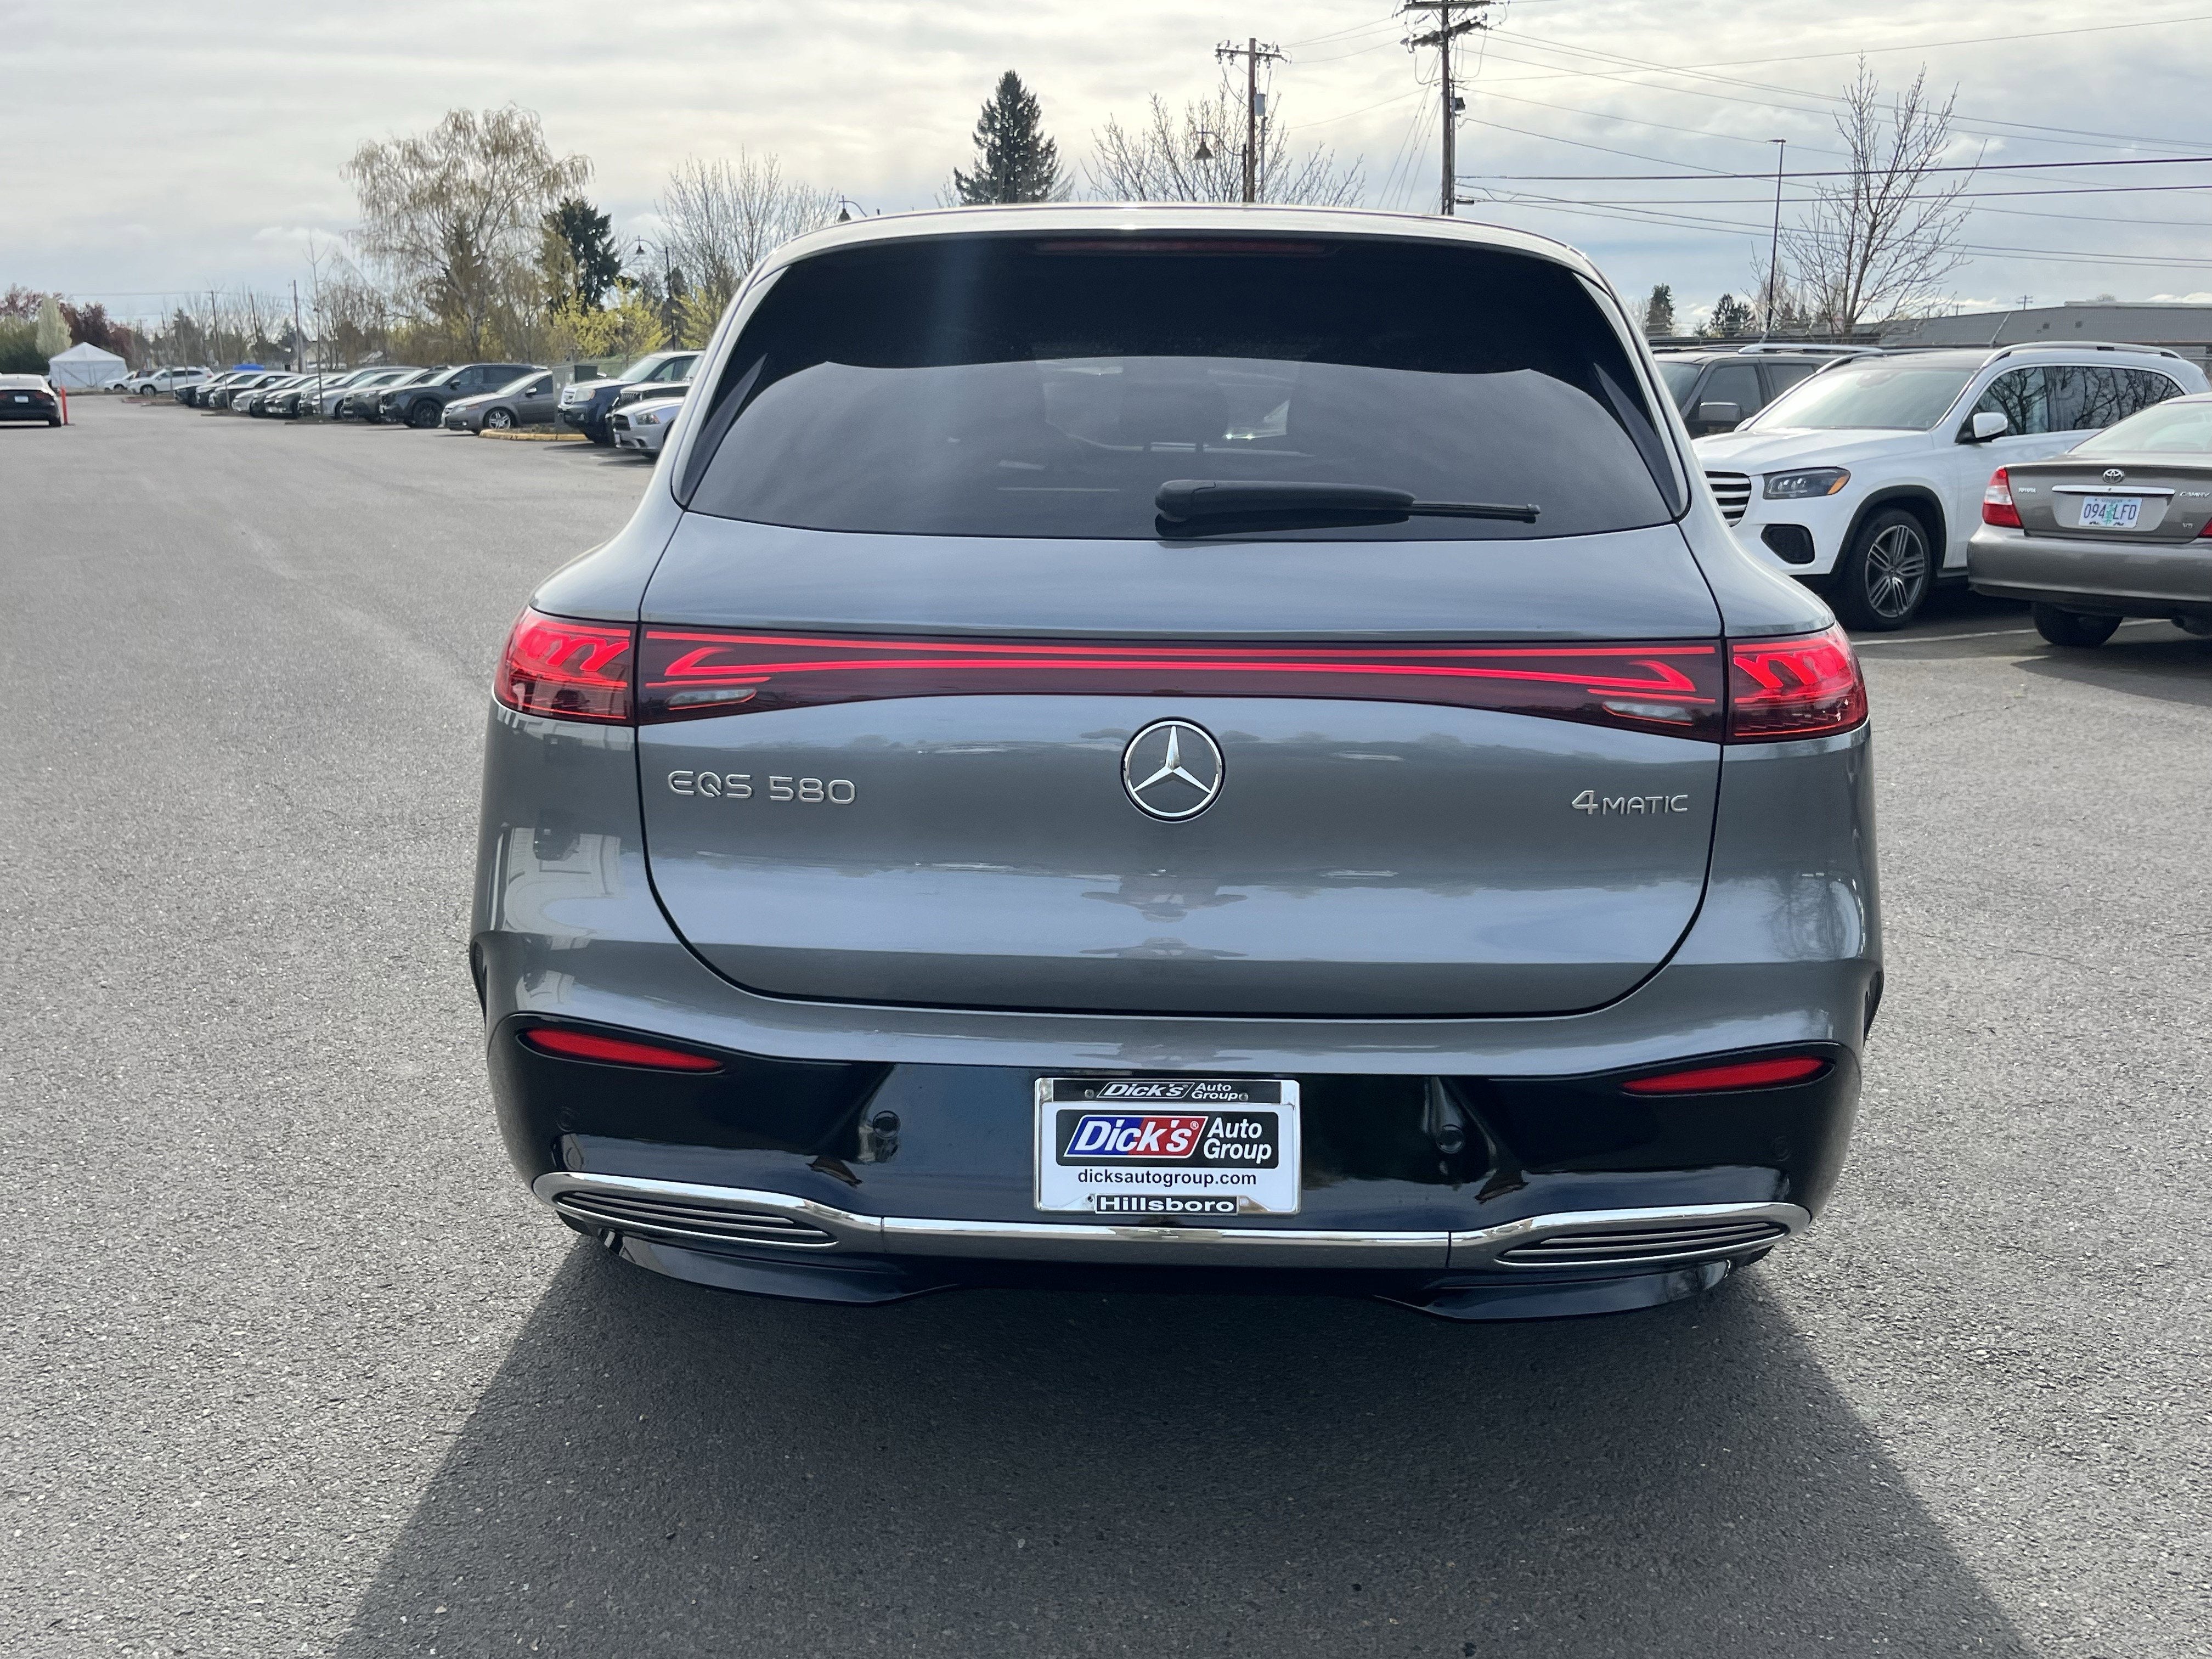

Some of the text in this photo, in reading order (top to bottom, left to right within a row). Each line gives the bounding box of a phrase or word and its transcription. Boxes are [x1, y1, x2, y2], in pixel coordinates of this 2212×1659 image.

[2084, 504, 2137, 520] 094 LFD
[668, 770, 856, 805] EQS 580
[1571, 790, 1689, 815] 4MATIC
[1191, 1091, 1238, 1101] Group
[1195, 1082, 1232, 1091] Auto
[1207, 1117, 1262, 1139] Auto
[1203, 1139, 1271, 1164] Group
[1077, 1169, 1257, 1188] dicksautogroup.com
[1099, 1196, 1234, 1212] Hillsboro
